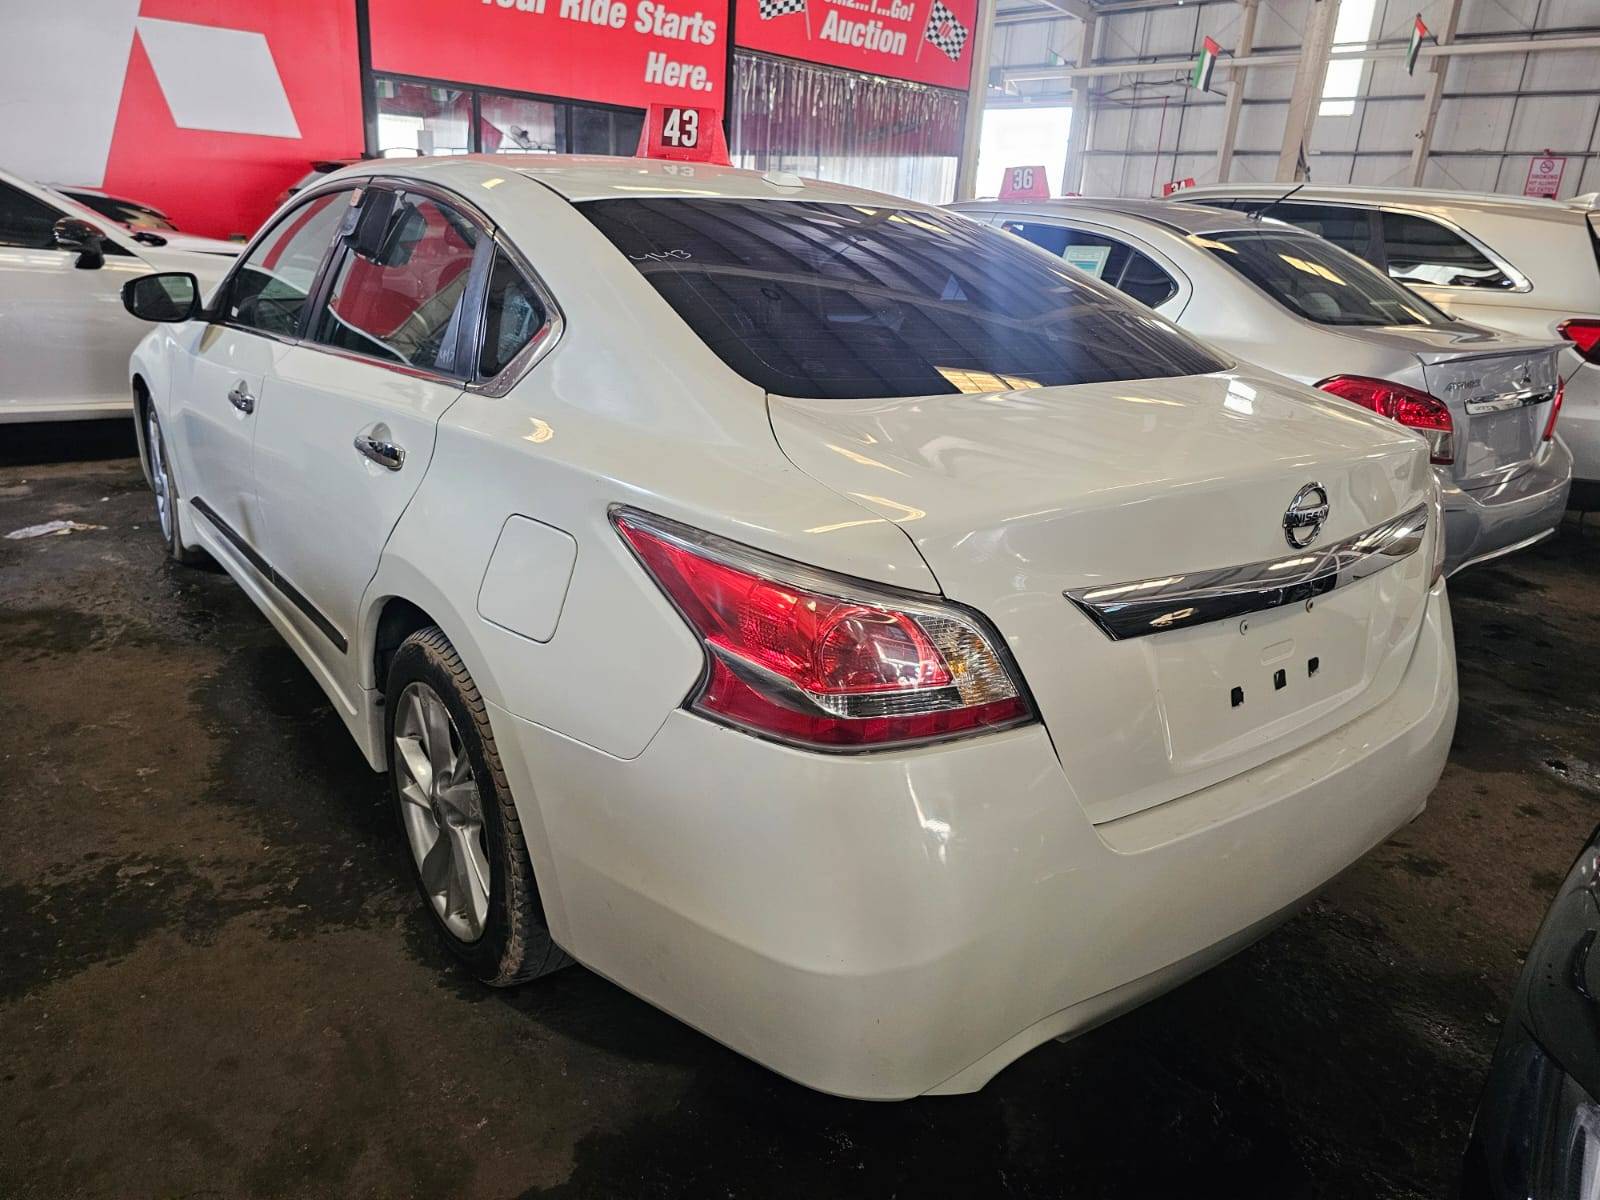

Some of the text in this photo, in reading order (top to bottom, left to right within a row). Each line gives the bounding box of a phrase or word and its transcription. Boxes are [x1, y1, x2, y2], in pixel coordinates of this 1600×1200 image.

[559, 0, 627, 29] Ride
[634, 0, 717, 46] Starts
[819, 9, 907, 56] Auction
[644, 51, 713, 92] Here.
[663, 108, 699, 147] 43
[1013, 169, 1033, 190] 36
